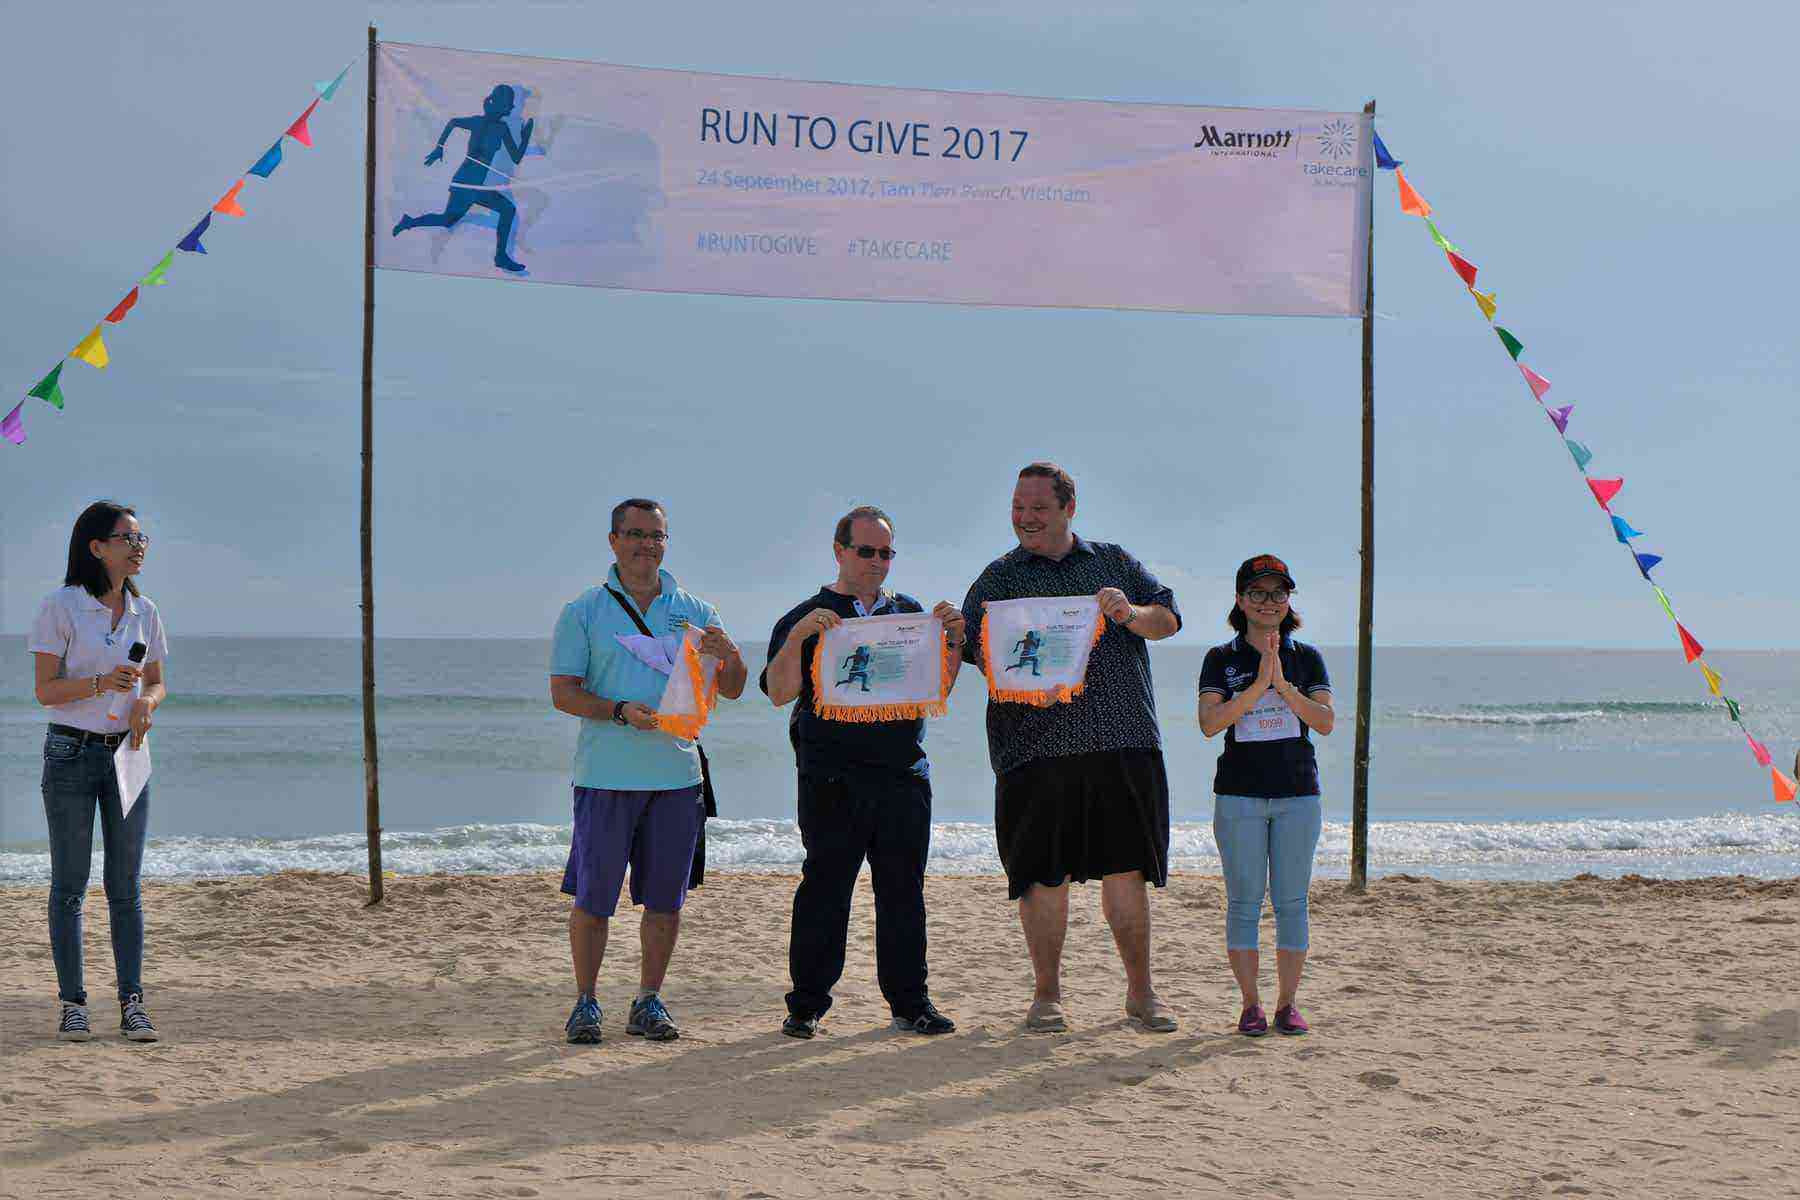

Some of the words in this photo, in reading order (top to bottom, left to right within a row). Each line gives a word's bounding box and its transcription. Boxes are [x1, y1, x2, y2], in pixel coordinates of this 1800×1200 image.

[700, 108, 777, 147] RUN
[787, 114, 837, 151] TO
[848, 119, 931, 157] GIVE
[941, 125, 1030, 162] 2017
[1194, 125, 1292, 148] Marriott
[1303, 160, 1368, 177] takecare
[696, 168, 717, 185] 24
[722, 169, 821, 193] September
[828, 176, 875, 198] 2017,
[880, 179, 914, 199] Tam
[1021, 182, 1090, 202] Vietnam
[697, 232, 817, 257] #RUNTOGIVE
[848, 239, 953, 262] #TAKECARE
